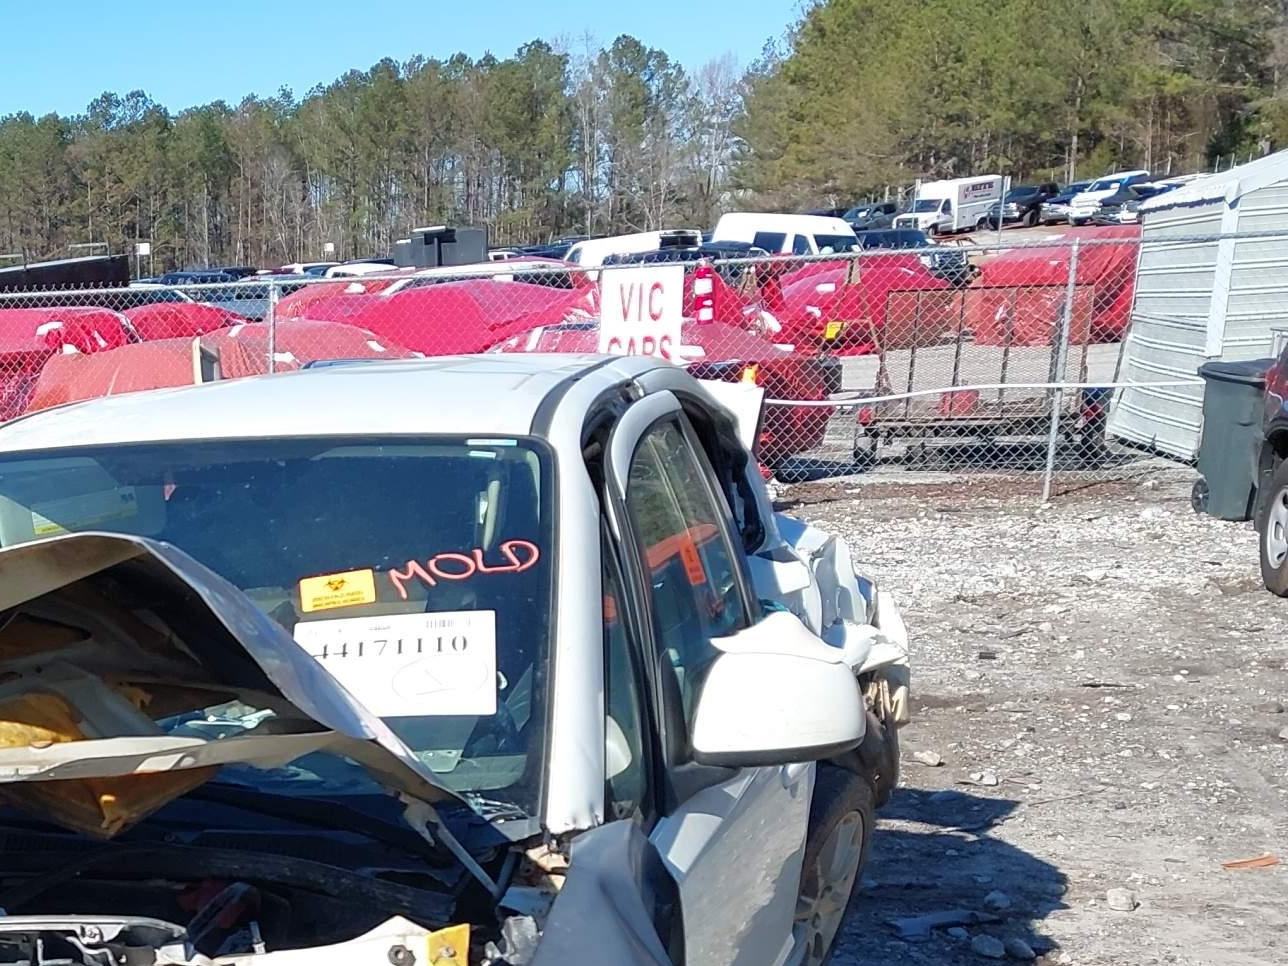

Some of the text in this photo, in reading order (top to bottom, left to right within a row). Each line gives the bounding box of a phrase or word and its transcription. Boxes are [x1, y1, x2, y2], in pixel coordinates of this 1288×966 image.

[620, 281, 665, 322] VIC
[388, 540, 540, 600] MOLD
[312, 635, 468, 659] 44171110
